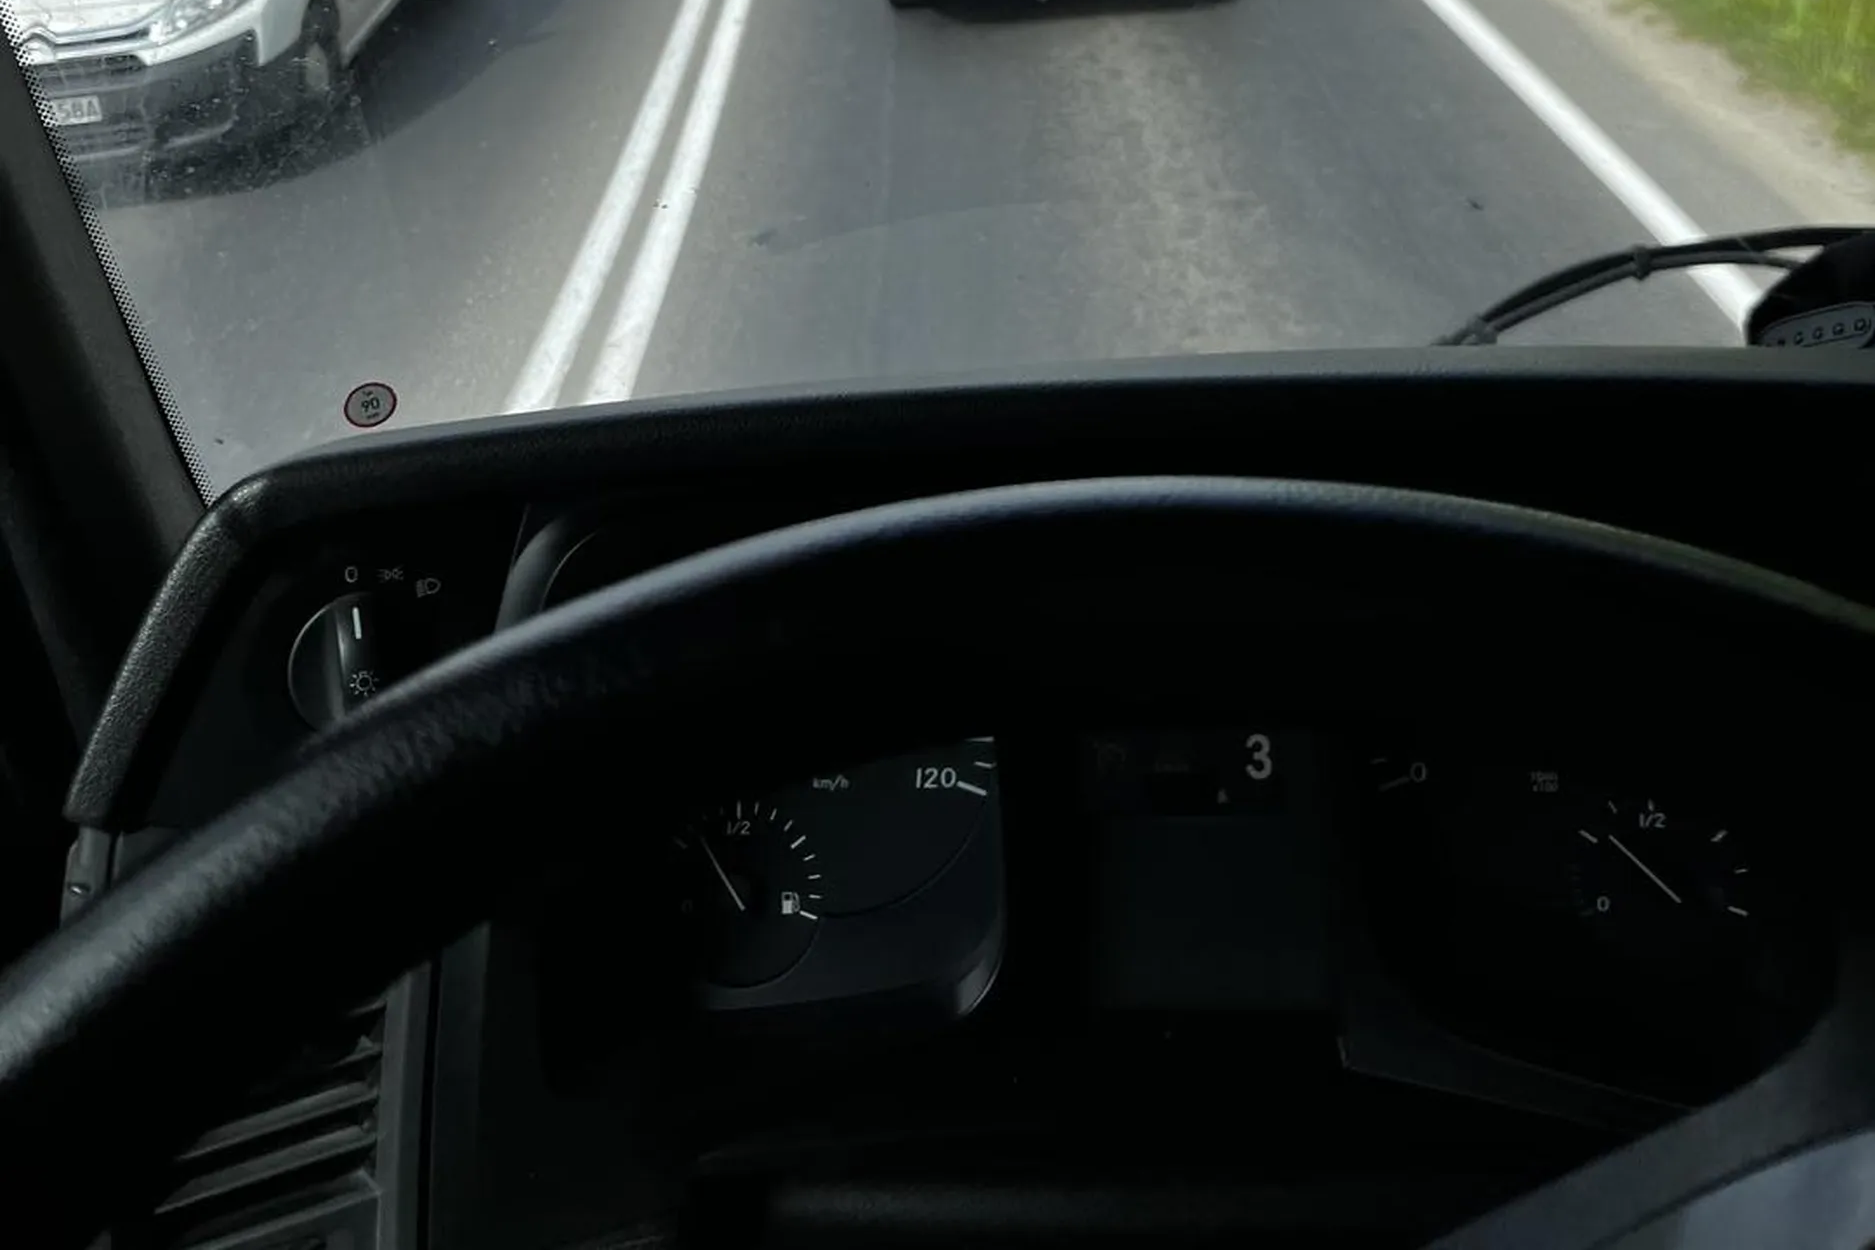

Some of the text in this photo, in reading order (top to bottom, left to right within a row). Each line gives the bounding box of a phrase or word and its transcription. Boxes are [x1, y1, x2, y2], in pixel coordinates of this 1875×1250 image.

[361, 396, 380, 413] 90
[1244, 733, 1274, 781] 3
[812, 774, 850, 791] km/h
[915, 766, 957, 790] 120
[726, 820, 751, 836] 1/2
[1638, 811, 1667, 829] 1/2
